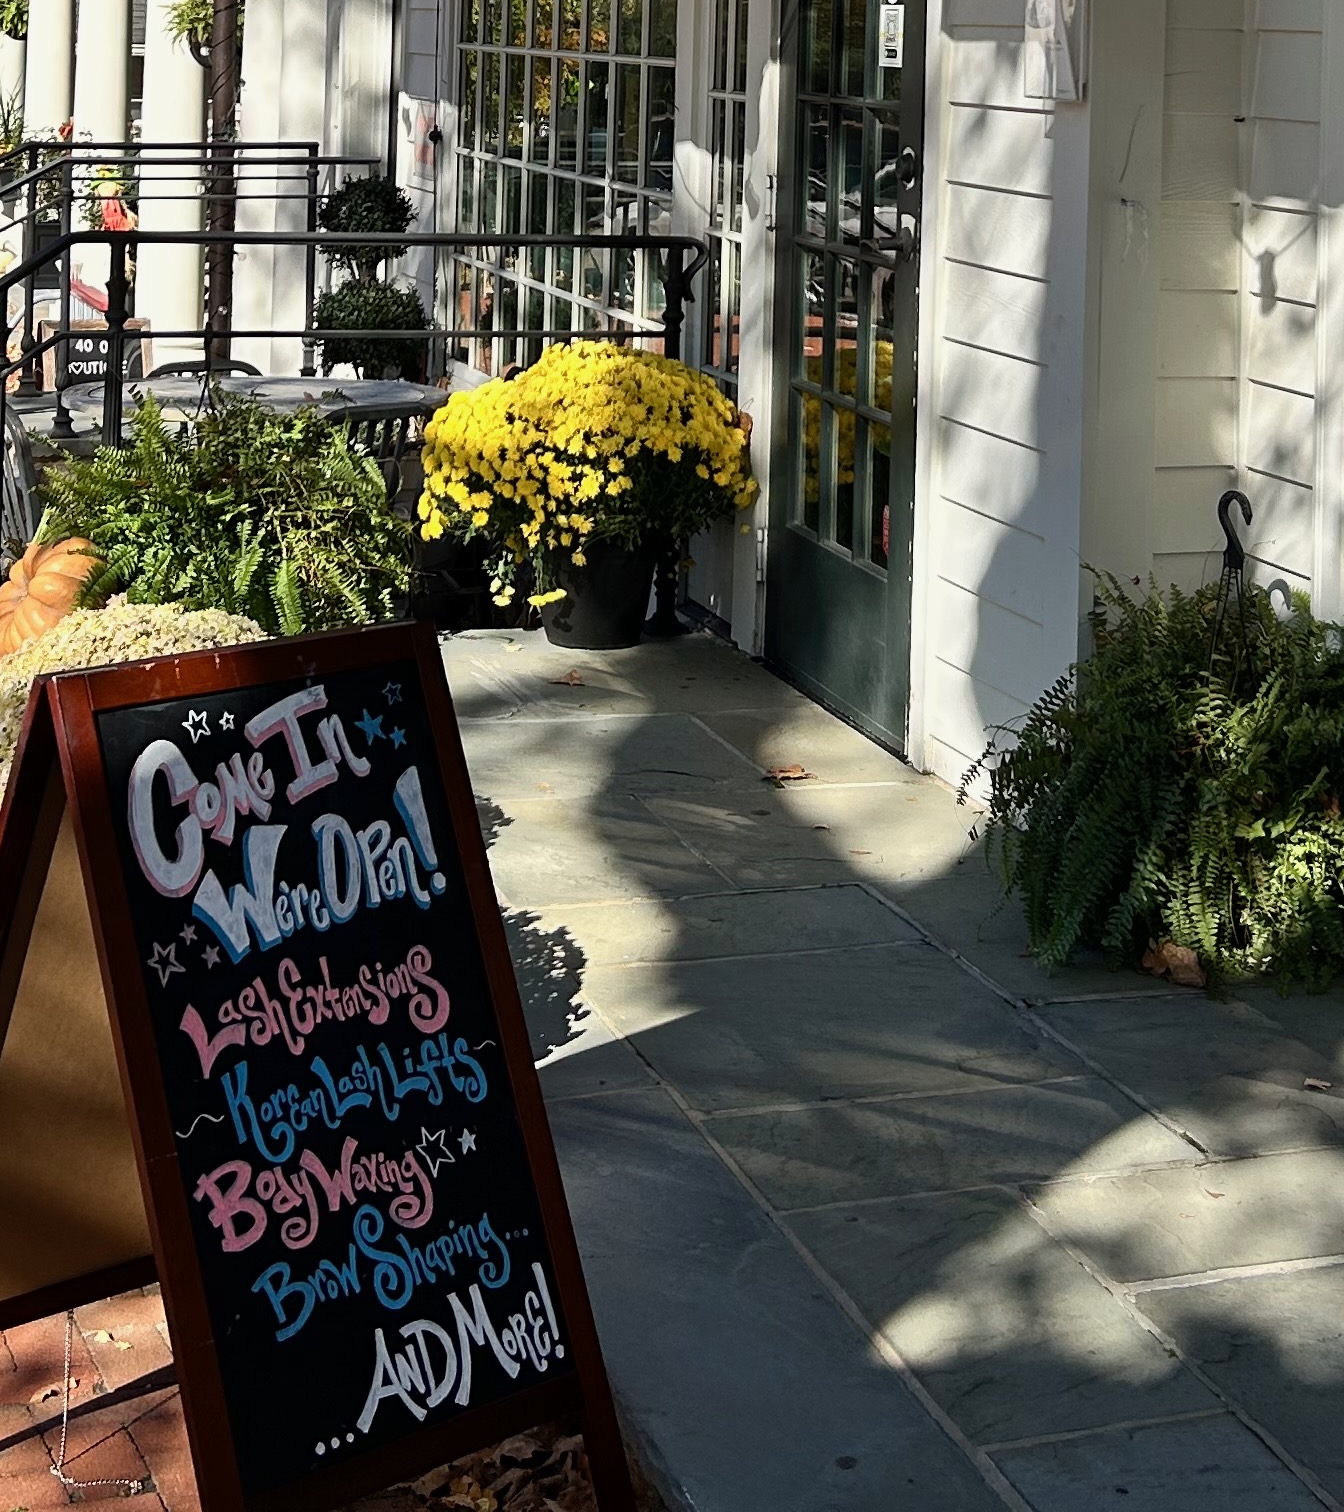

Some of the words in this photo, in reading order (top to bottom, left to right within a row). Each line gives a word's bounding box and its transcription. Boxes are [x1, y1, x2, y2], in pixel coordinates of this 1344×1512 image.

[75, 338, 94, 353] 40
[244, 684, 372, 805] In
[179, 976, 306, 1079] Lash
[277, 944, 451, 1055] Extensions
[221, 1060, 342, 1164] Korean
[310, 1044, 401, 1122] Lash
[377, 1032, 488, 1106] Lifts
[193, 1160, 319, 1252] Body
[300, 1136, 434, 1229] Waxing
[251, 1243, 362, 1342] Brow
